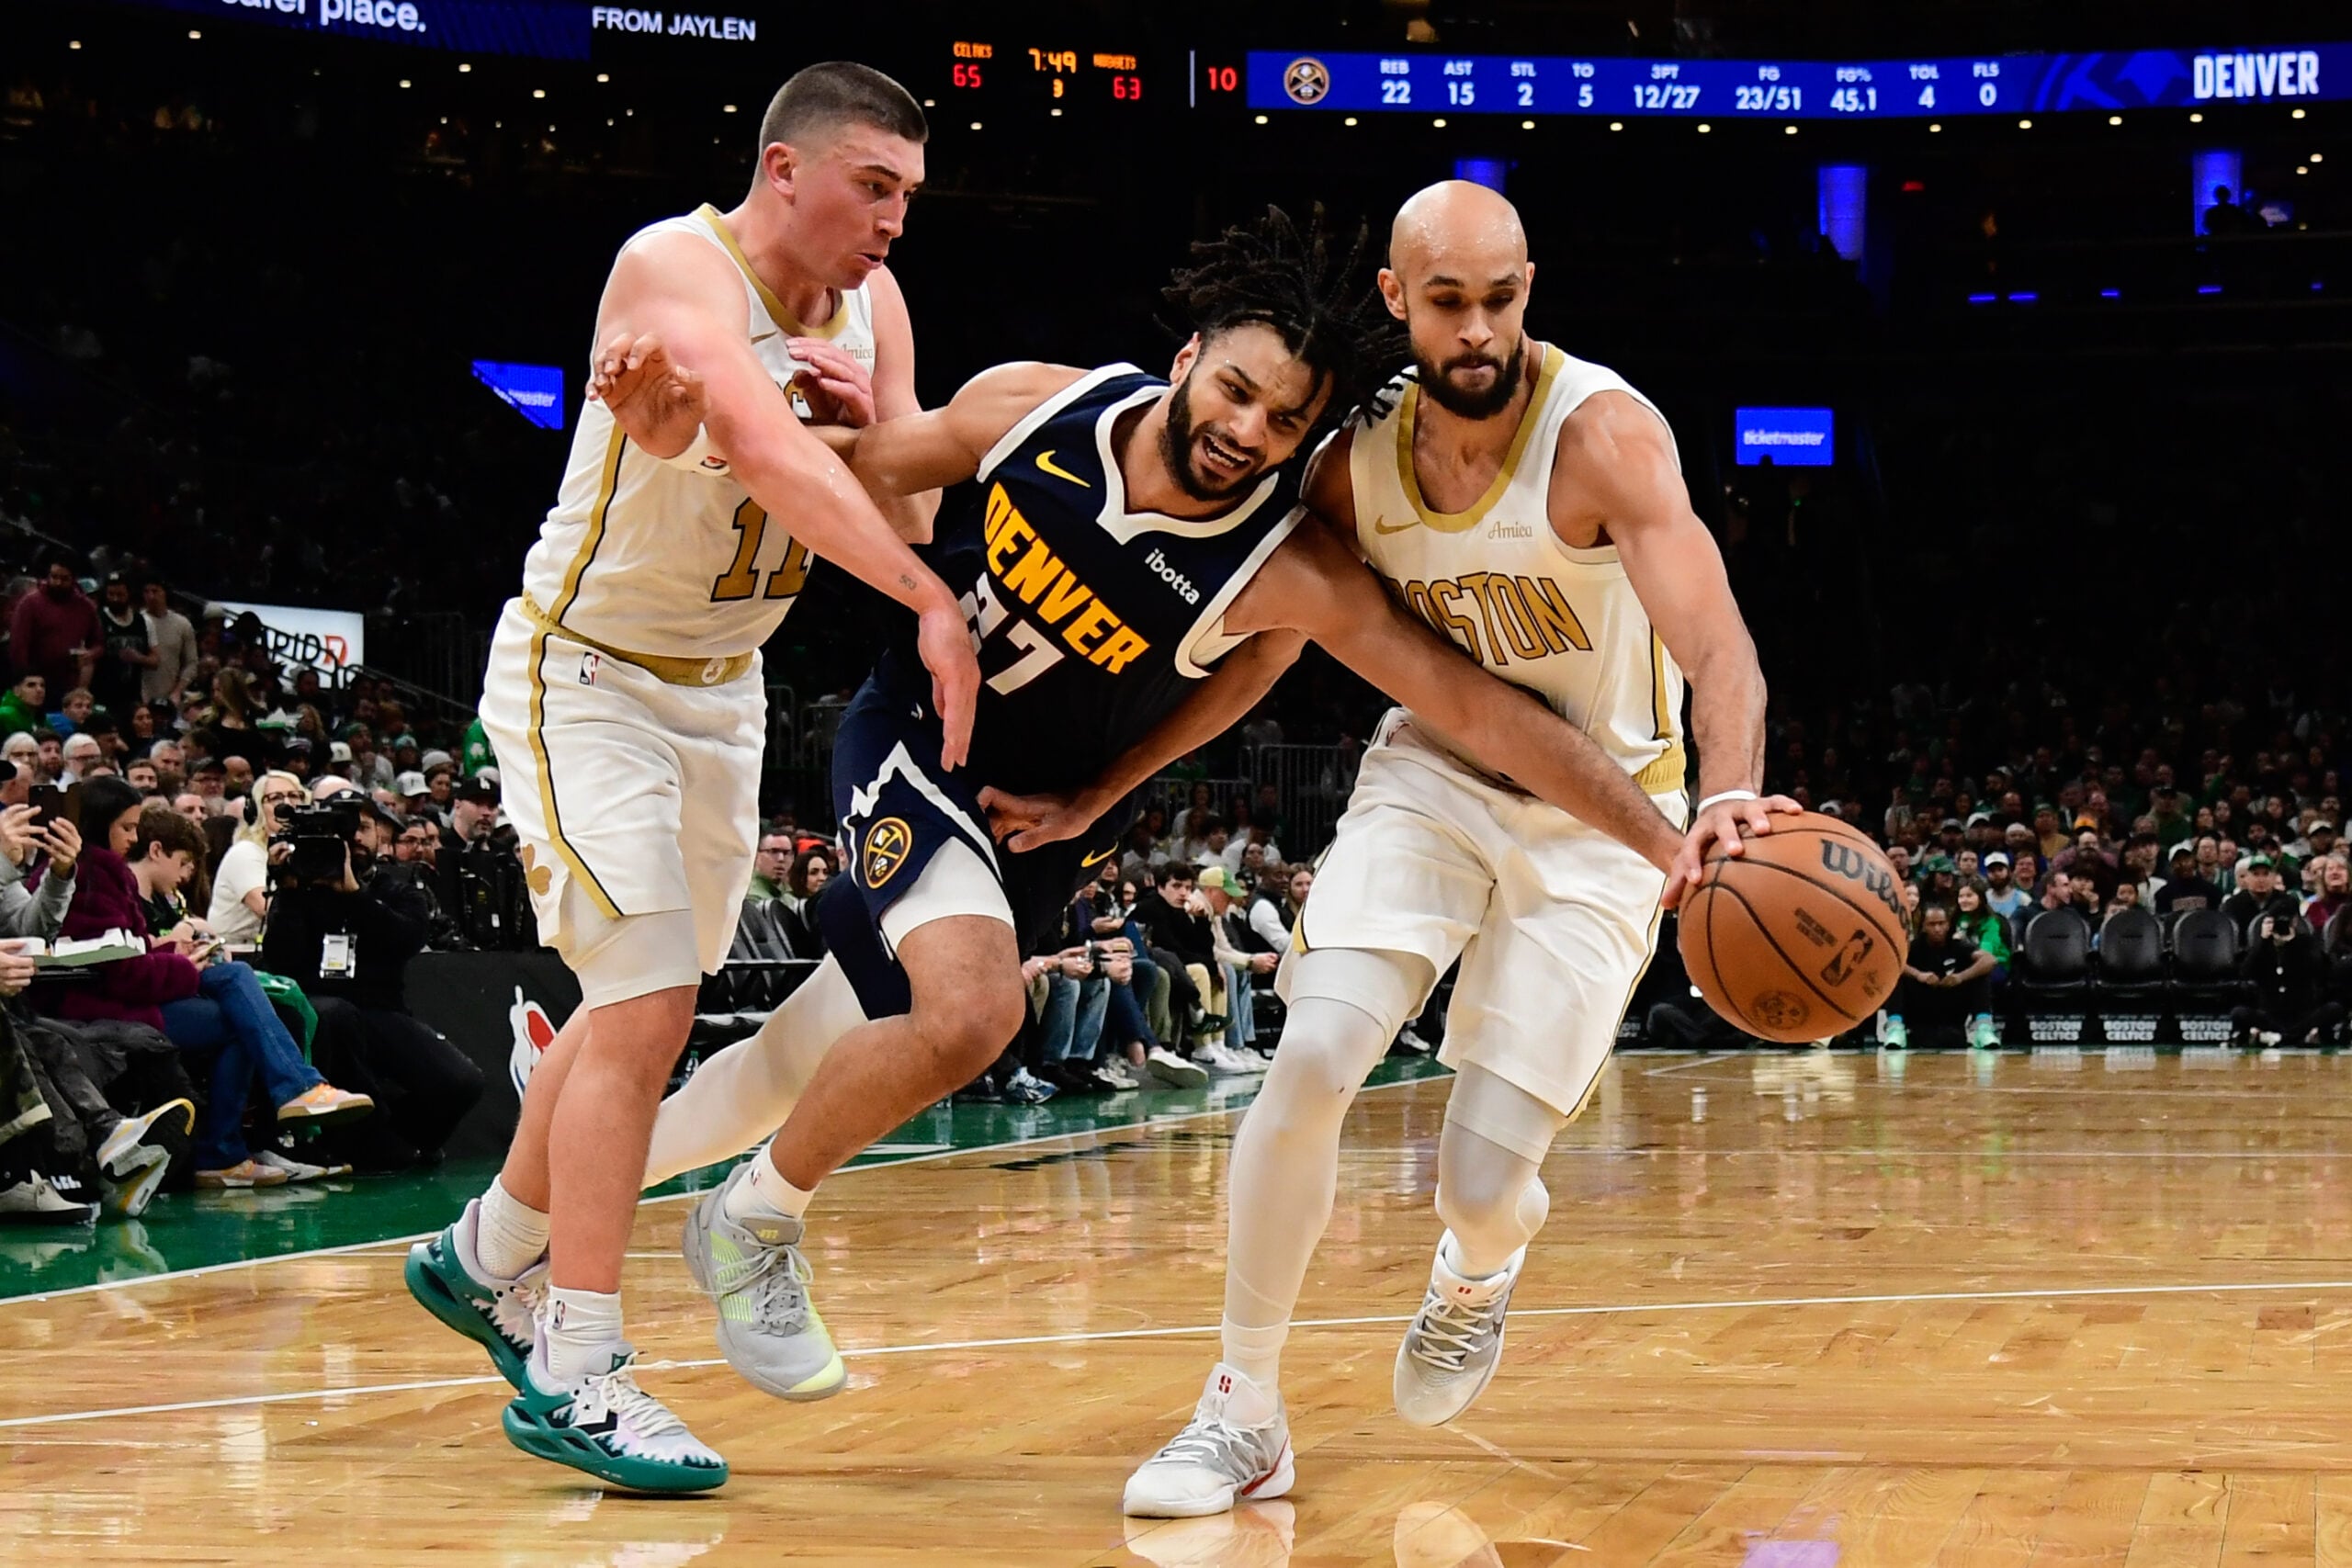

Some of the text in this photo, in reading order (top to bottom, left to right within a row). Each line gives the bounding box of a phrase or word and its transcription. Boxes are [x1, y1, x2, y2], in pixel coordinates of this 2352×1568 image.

[320, 0, 426, 32] place.
[592, 6, 756, 41] FROM JAYLEN
[1028, 48, 1077, 73] 7:49
[1380, 59, 2000, 83] REB AST STL TO 3PT FG FG% TOL FLS
[954, 63, 981, 87] 65
[1208, 67, 1238, 91] 10
[2193, 51, 2320, 99] DENVER
[1053, 78, 1063, 98] 3
[1114, 76, 1141, 100] 63
[1382, 80, 1997, 111] 22 15 2 5 12/27 23/51 45.1 4 0
[1744, 429, 1825, 446] ticketmaster
[1487, 521, 1533, 539] Amica
[984, 481, 1150, 674] DENVER
[1145, 548, 1200, 604] ibotta
[2030, 1021, 2082, 1031] BOSTON
[2031, 1031, 2079, 1040] CELTICS
[2103, 1021, 2157, 1031] BOSTON
[2106, 1031, 2154, 1040] CELTICS
[2179, 1021, 2233, 1031] BOSTON
[2182, 1031, 2231, 1040] CELTICS
